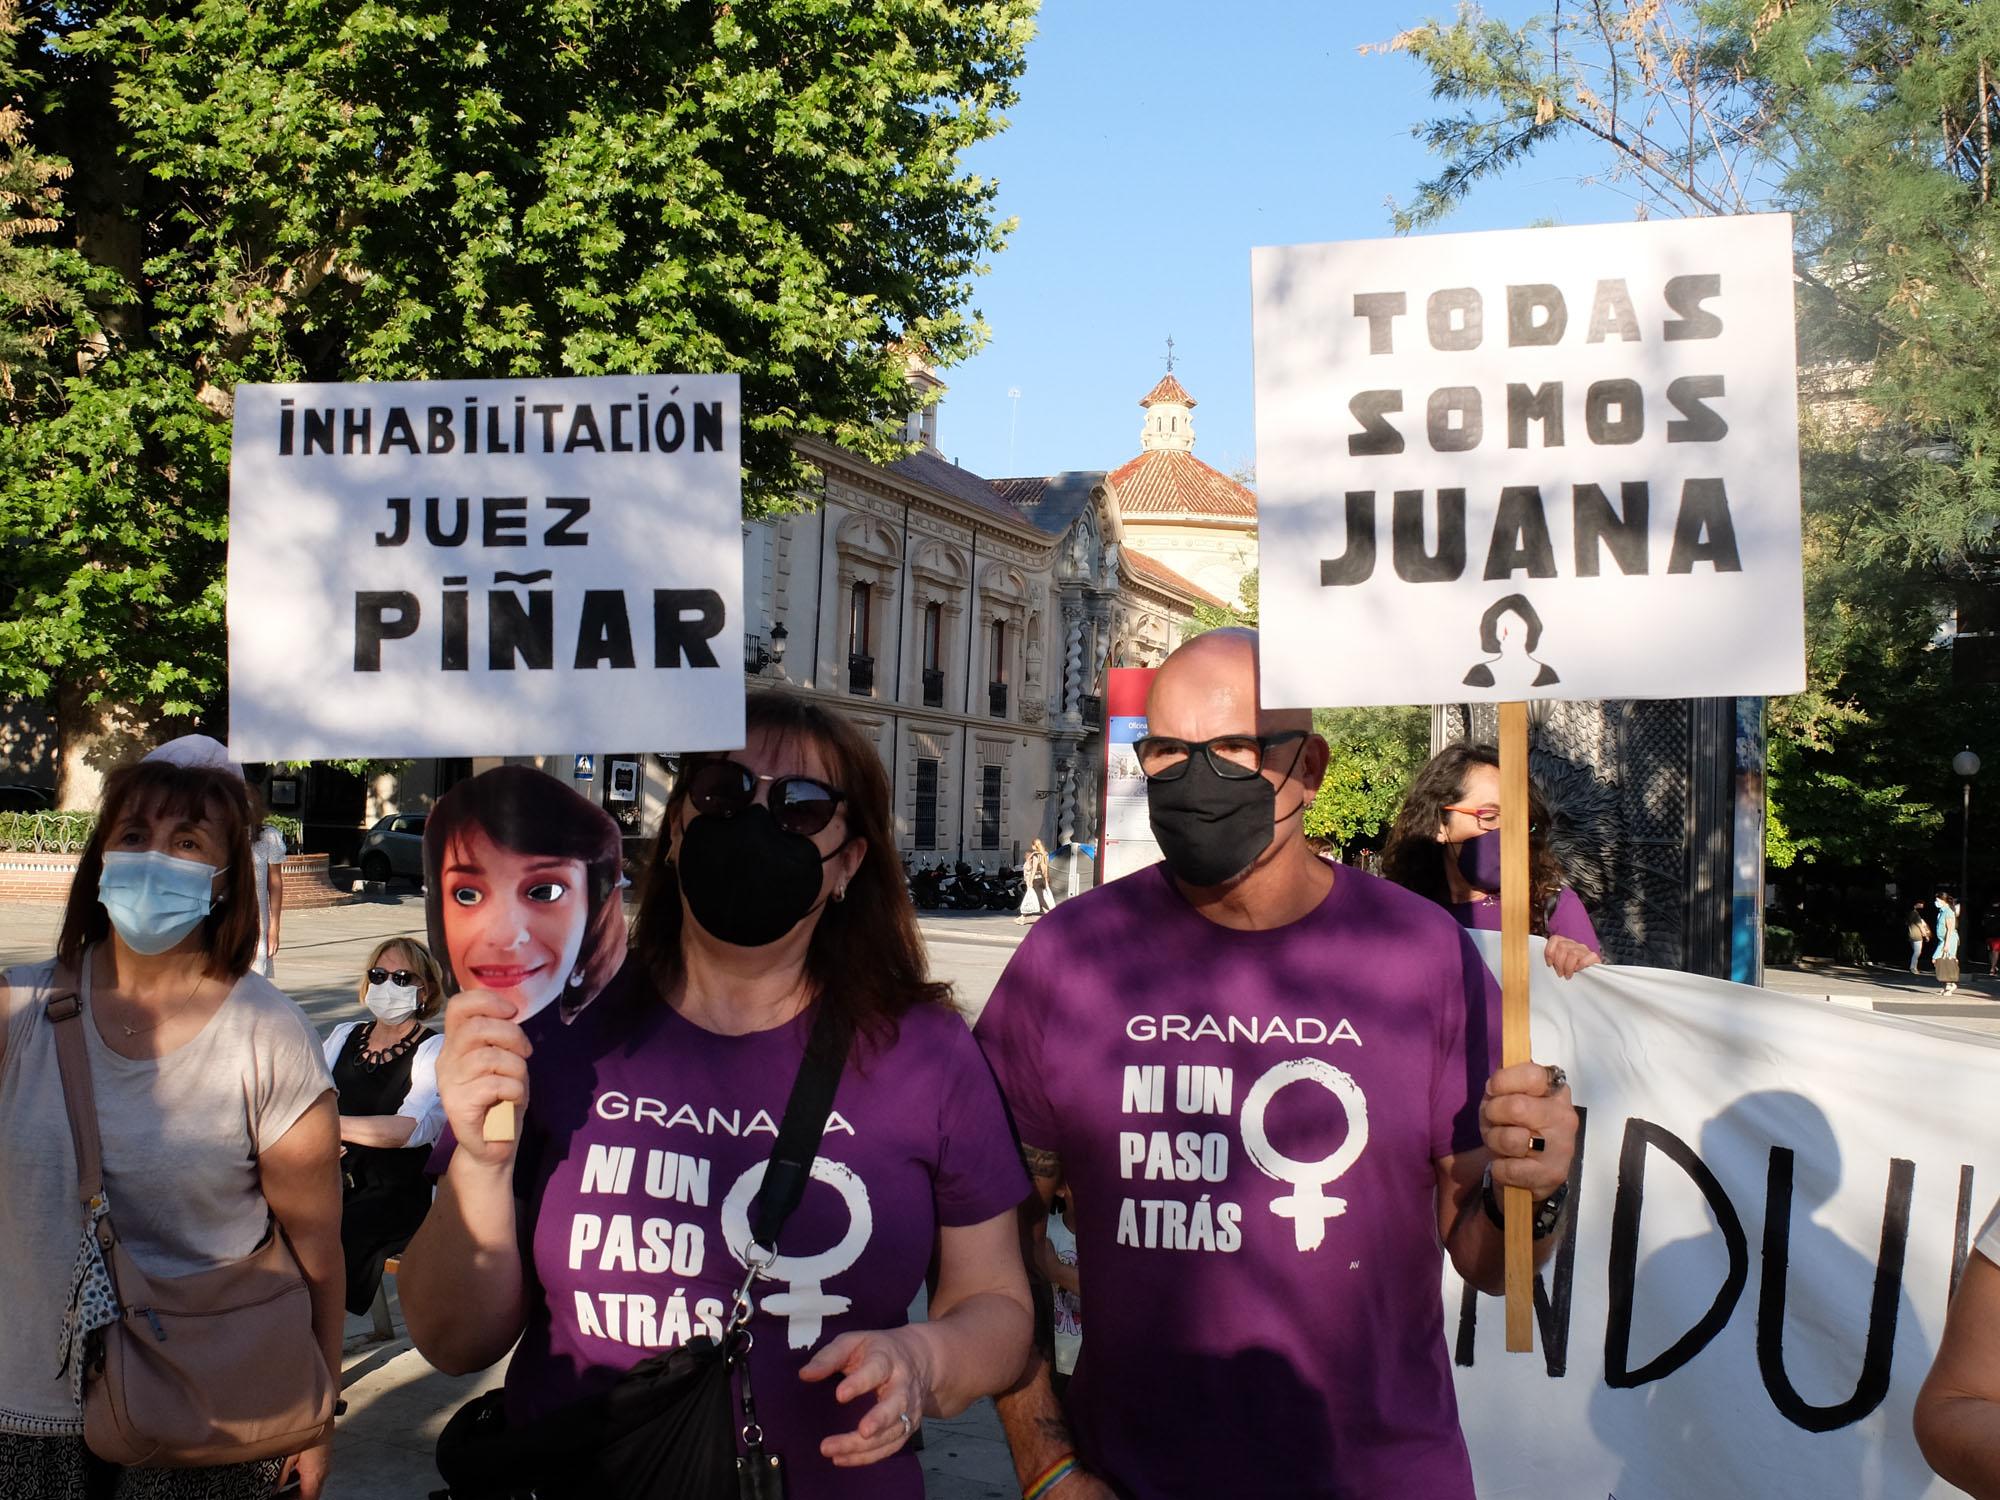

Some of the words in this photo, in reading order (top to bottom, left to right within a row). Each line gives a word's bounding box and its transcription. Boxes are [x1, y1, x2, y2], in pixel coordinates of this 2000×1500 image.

[1353, 274, 1723, 354] TODAS
[278, 385, 724, 456] INHABILITACIÓN
[1348, 375, 1729, 456] SOMOS
[375, 496, 591, 548] JUEZ
[1320, 478, 1743, 587] JUANA
[353, 569, 726, 672] PIÑAR
[1126, 1014, 1363, 1047] GRANADA
[596, 1091, 855, 1138] GRANAA
[1122, 1065, 1166, 1114] NI
[1176, 1064, 1234, 1116] UN
[579, 1143, 637, 1195] NI
[644, 1149, 711, 1207] UN
[1119, 1131, 1229, 1182] PASO
[569, 1213, 705, 1277] PASO
[1116, 1193, 1243, 1253] ATRÁS
[574, 1287, 724, 1347] ATRÁS
